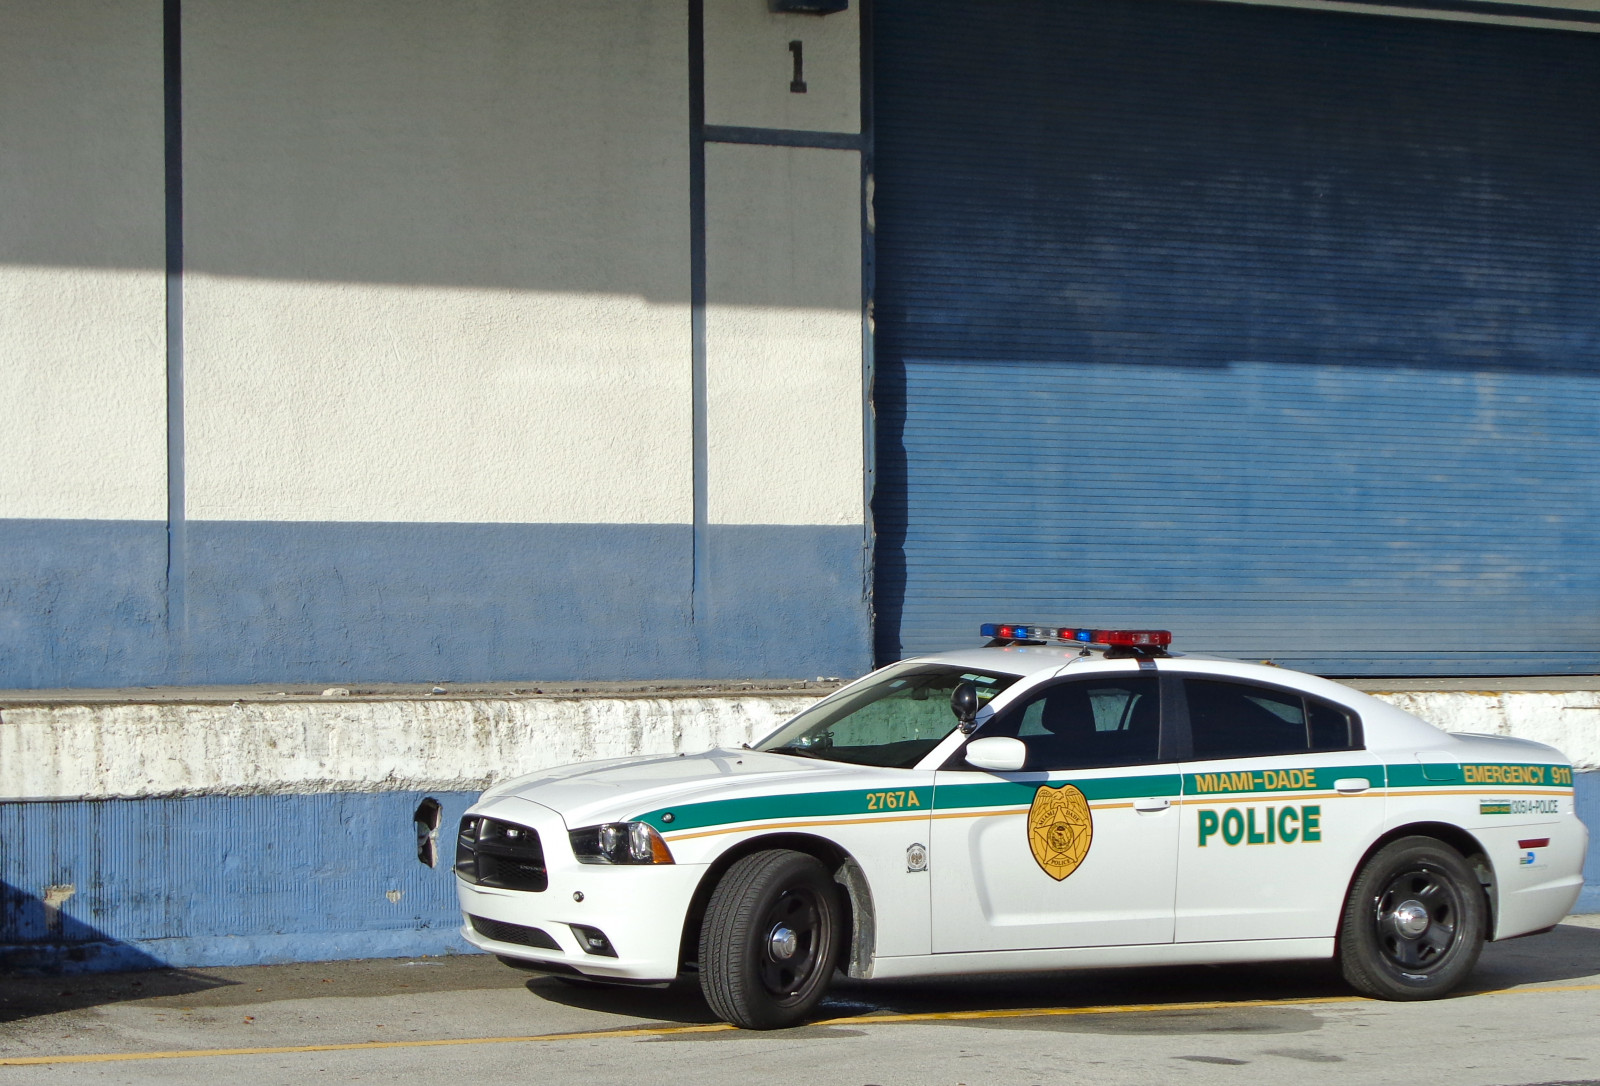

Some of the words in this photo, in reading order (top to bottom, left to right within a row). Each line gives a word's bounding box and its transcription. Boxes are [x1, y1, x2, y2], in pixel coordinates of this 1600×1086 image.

[788, 40, 807, 93] 1
[1195, 769, 1316, 792] MIAMI-DADE
[1463, 766, 1544, 783] EMERGENCY
[1551, 767, 1571, 784] 911
[866, 790, 919, 810] 2767A
[1038, 810, 1056, 826] MIAMI
[1065, 810, 1081, 822] DADE
[1197, 805, 1321, 847] POLICE
